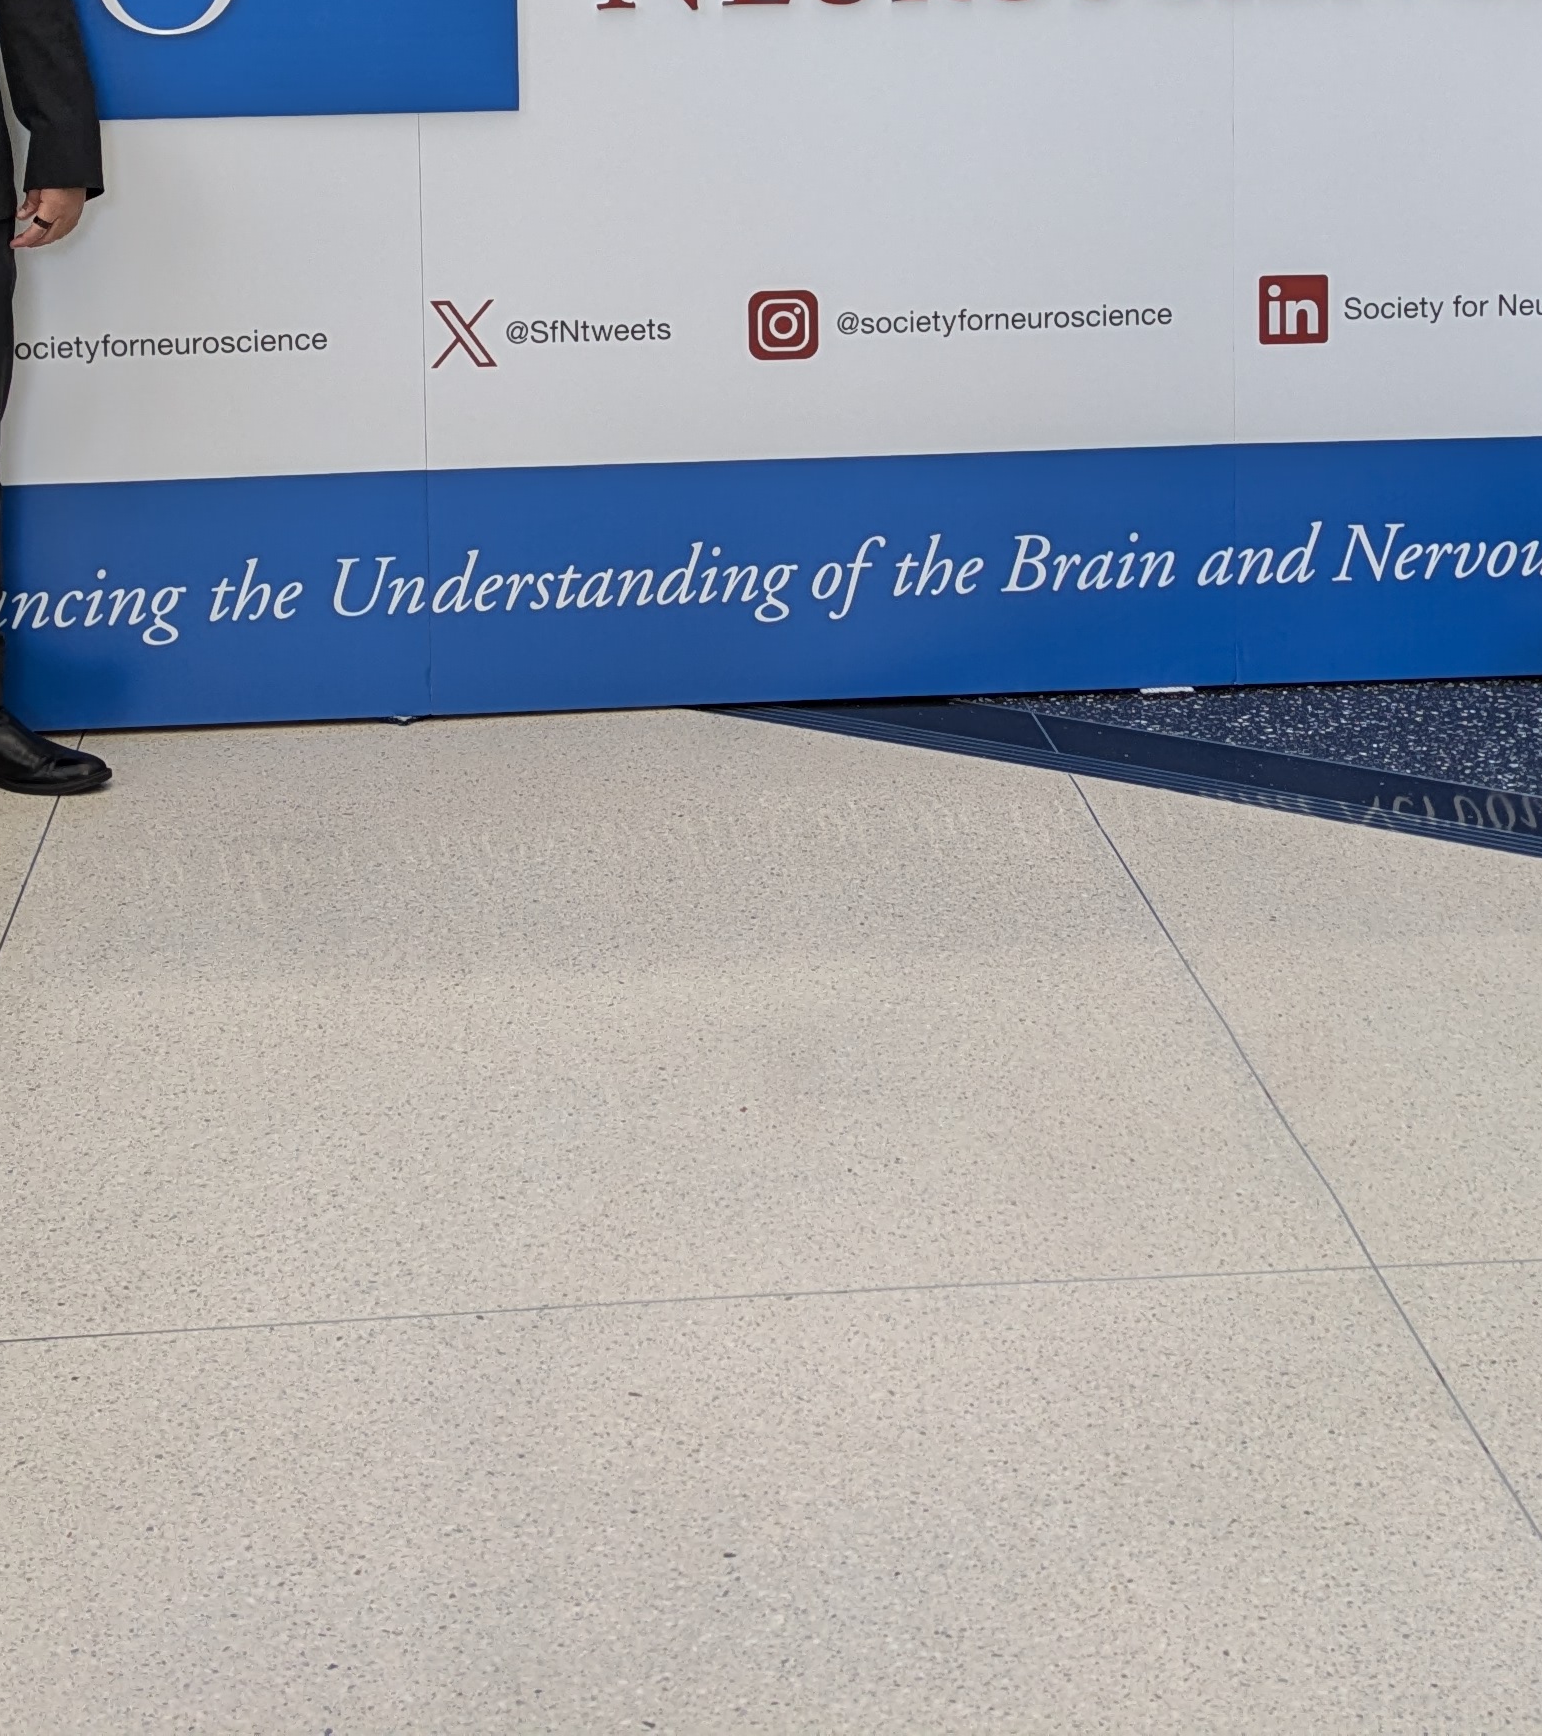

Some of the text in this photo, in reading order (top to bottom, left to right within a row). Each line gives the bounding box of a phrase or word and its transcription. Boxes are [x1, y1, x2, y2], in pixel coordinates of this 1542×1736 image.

[836, 303, 1174, 339] @societyforneuroscience
[1343, 294, 1443, 324] Society
[1453, 293, 1485, 320] for
[14, 328, 329, 365] ocietyforneuroscience
[505, 316, 672, 346] @SfNtweets
[208, 558, 304, 623] the
[332, 541, 799, 623] Understanding
[810, 535, 886, 620] of
[893, 534, 984, 597] the
[1001, 531, 1176, 594] Brain
[1196, 520, 1323, 587] and
